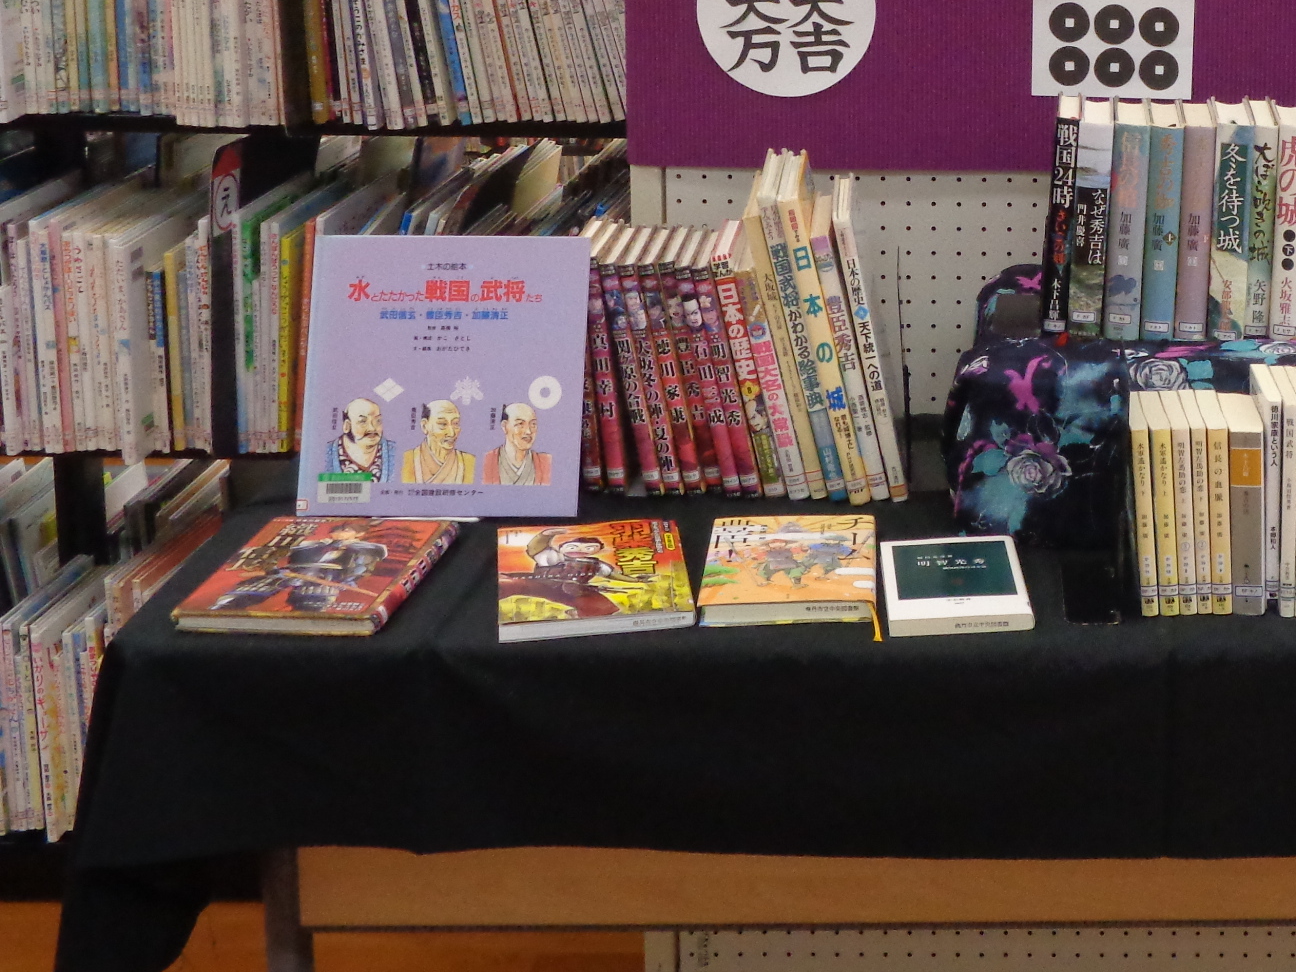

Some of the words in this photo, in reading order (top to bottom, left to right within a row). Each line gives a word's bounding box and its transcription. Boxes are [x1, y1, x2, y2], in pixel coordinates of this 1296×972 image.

[1053, 124, 1078, 208] 戦国24時
[1216, 143, 1247, 254] 冬を待つ城
[1249, 142, 1275, 266] 大ぼら吹きの城
[1087, 189, 1107, 265] なぜ秀吉は
[347, 278, 544, 303] 水とたたかった戦国の武将たち
[427, 262, 468, 271] 土木の絵本
[846, 258, 865, 306] 日本の歴史
[1252, 279, 1267, 324] 矢野隆
[1279, 276, 1293, 327] 火坂雅志
[716, 282, 758, 380] 日本の歴史
[769, 242, 825, 410] 戦国武将がわかる絵事典
[793, 246, 848, 411] 日本の城
[826, 295, 857, 372] 豊臣秀吉
[857, 321, 883, 392] 天下統一への道
[656, 338, 687, 424] 徳川家康
[676, 336, 706, 421] 豊臣秀吉
[693, 343, 725, 426] 石田三成
[711, 343, 742, 427] 明智光秀
[1213, 441, 1224, 502] 信長の血脈
[1270, 405, 1279, 467] 徳川家康という人
[1285, 418, 1295, 459] 戦国武将
